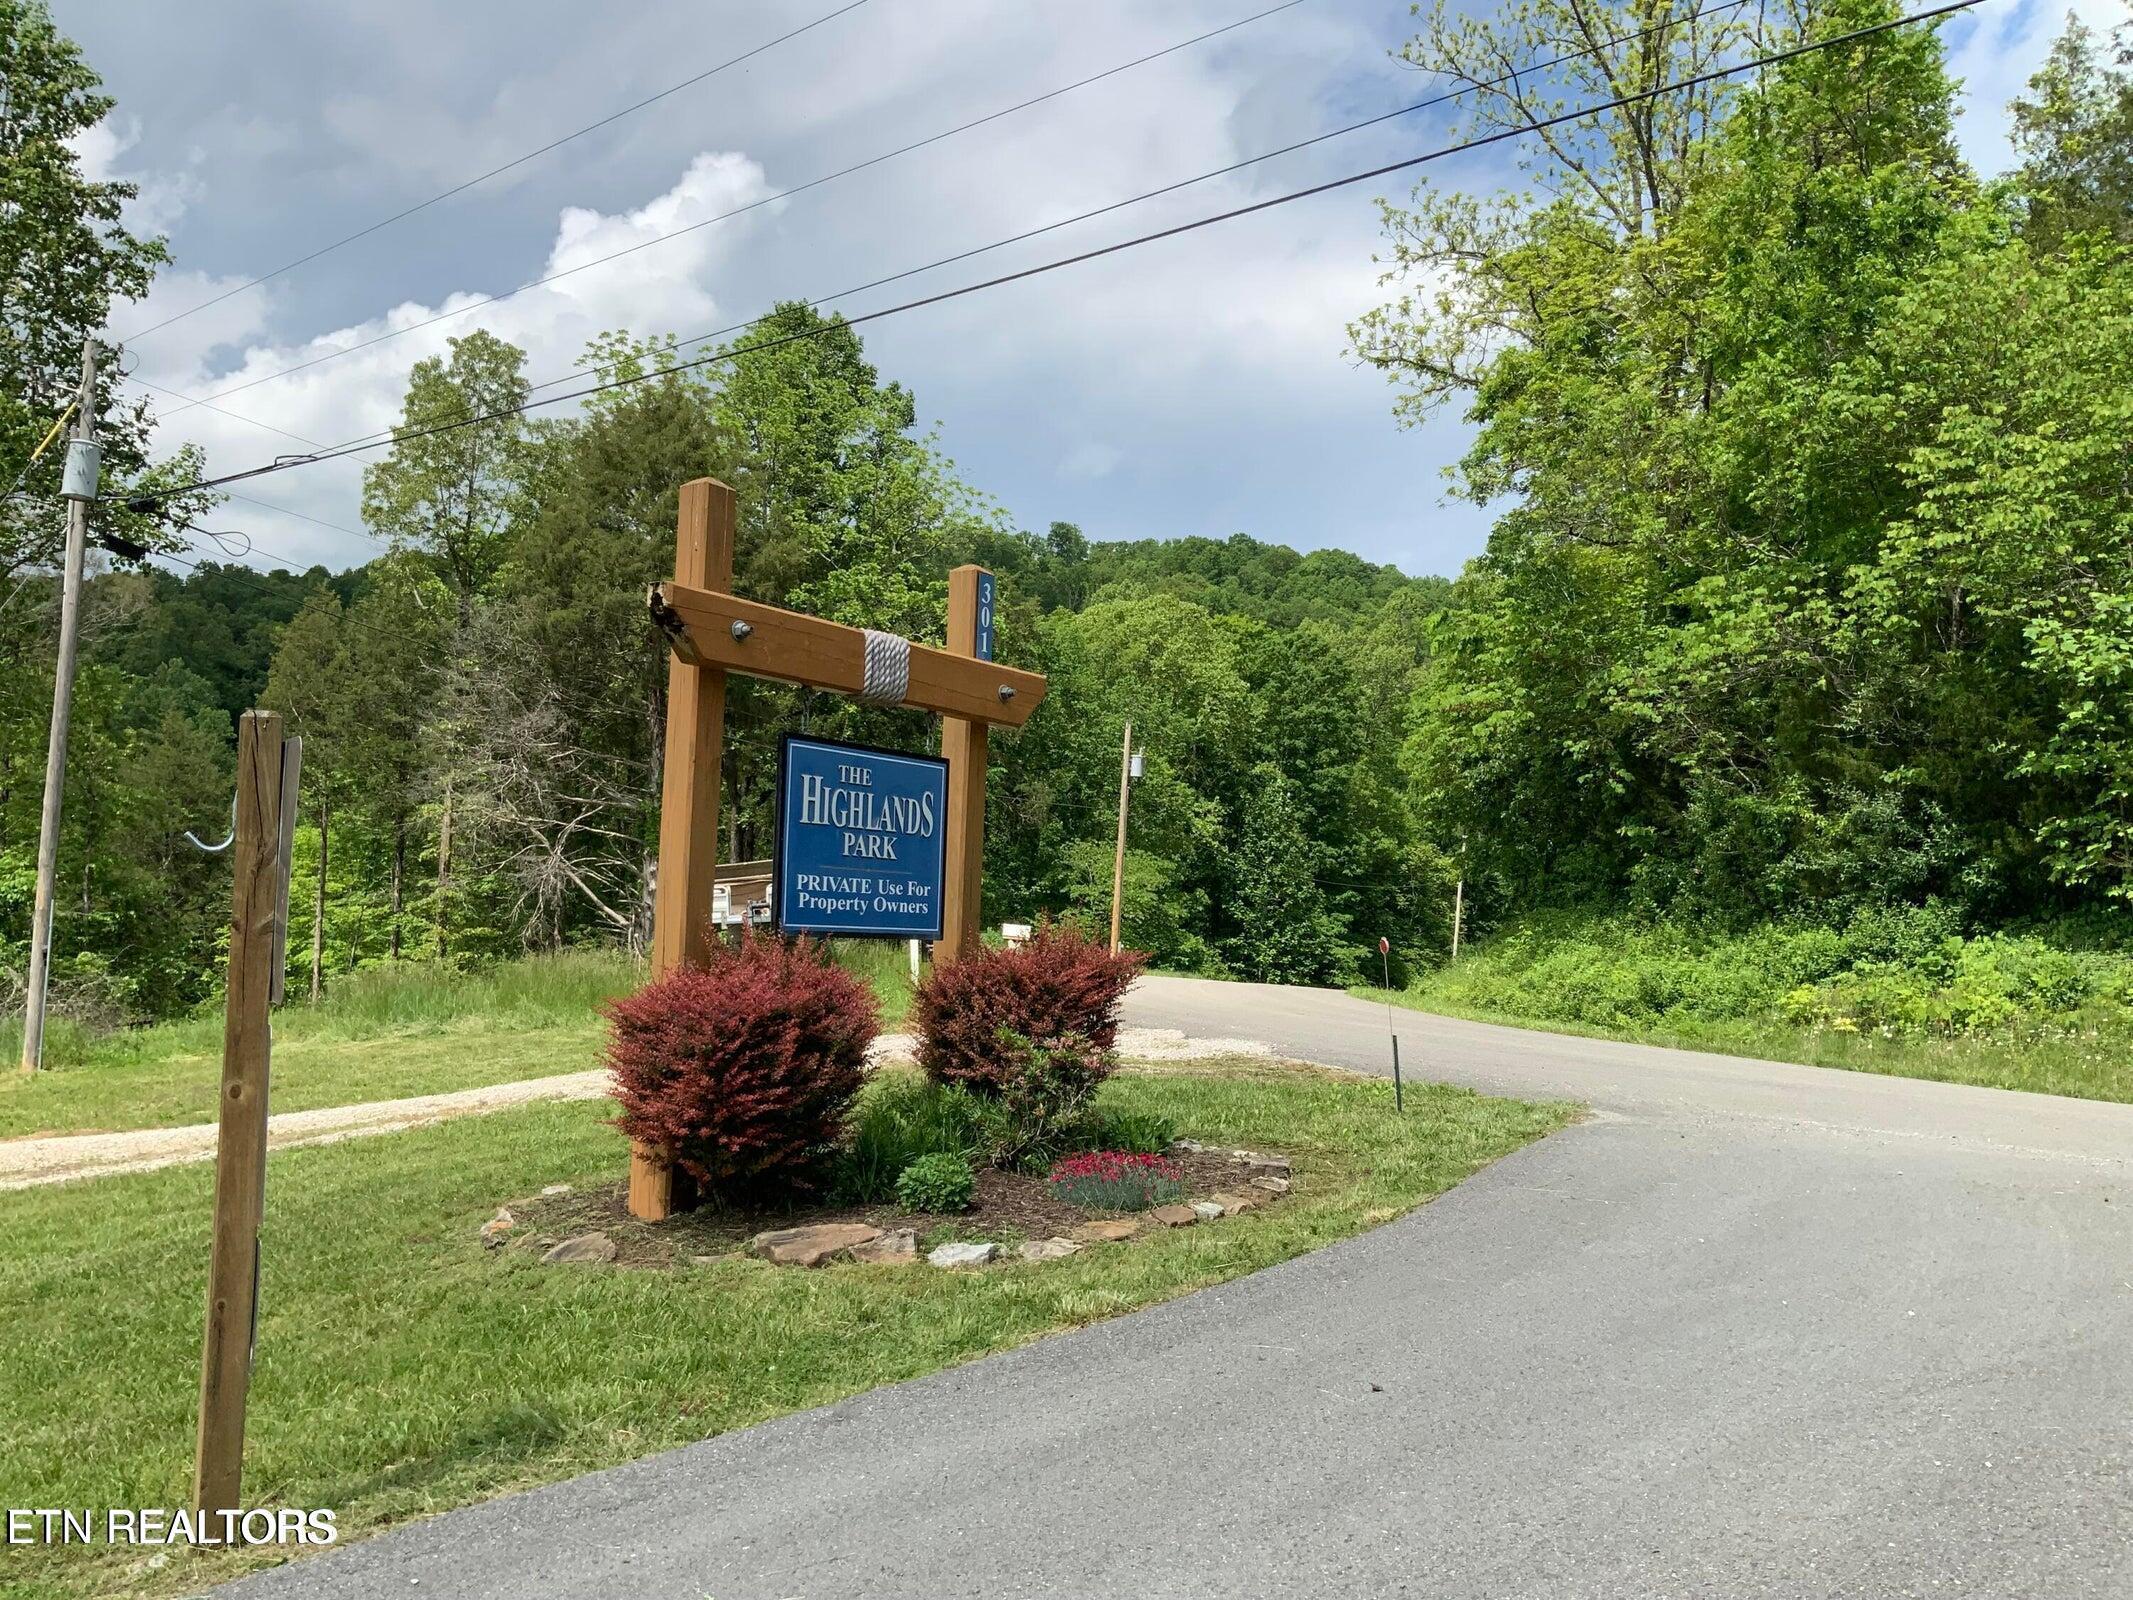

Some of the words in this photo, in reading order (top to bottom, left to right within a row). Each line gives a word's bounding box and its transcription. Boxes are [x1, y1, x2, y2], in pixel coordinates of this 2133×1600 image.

[981, 582, 991, 653] 301
[838, 765, 872, 786] THE
[799, 774, 934, 838] HIGHLANDS
[842, 832, 898, 860] PARK
[797, 874, 872, 895] PRIVATE
[878, 879, 904, 896] Use
[907, 881, 931, 897] For
[798, 892, 869, 915] Property
[873, 896, 929, 914] Owners
